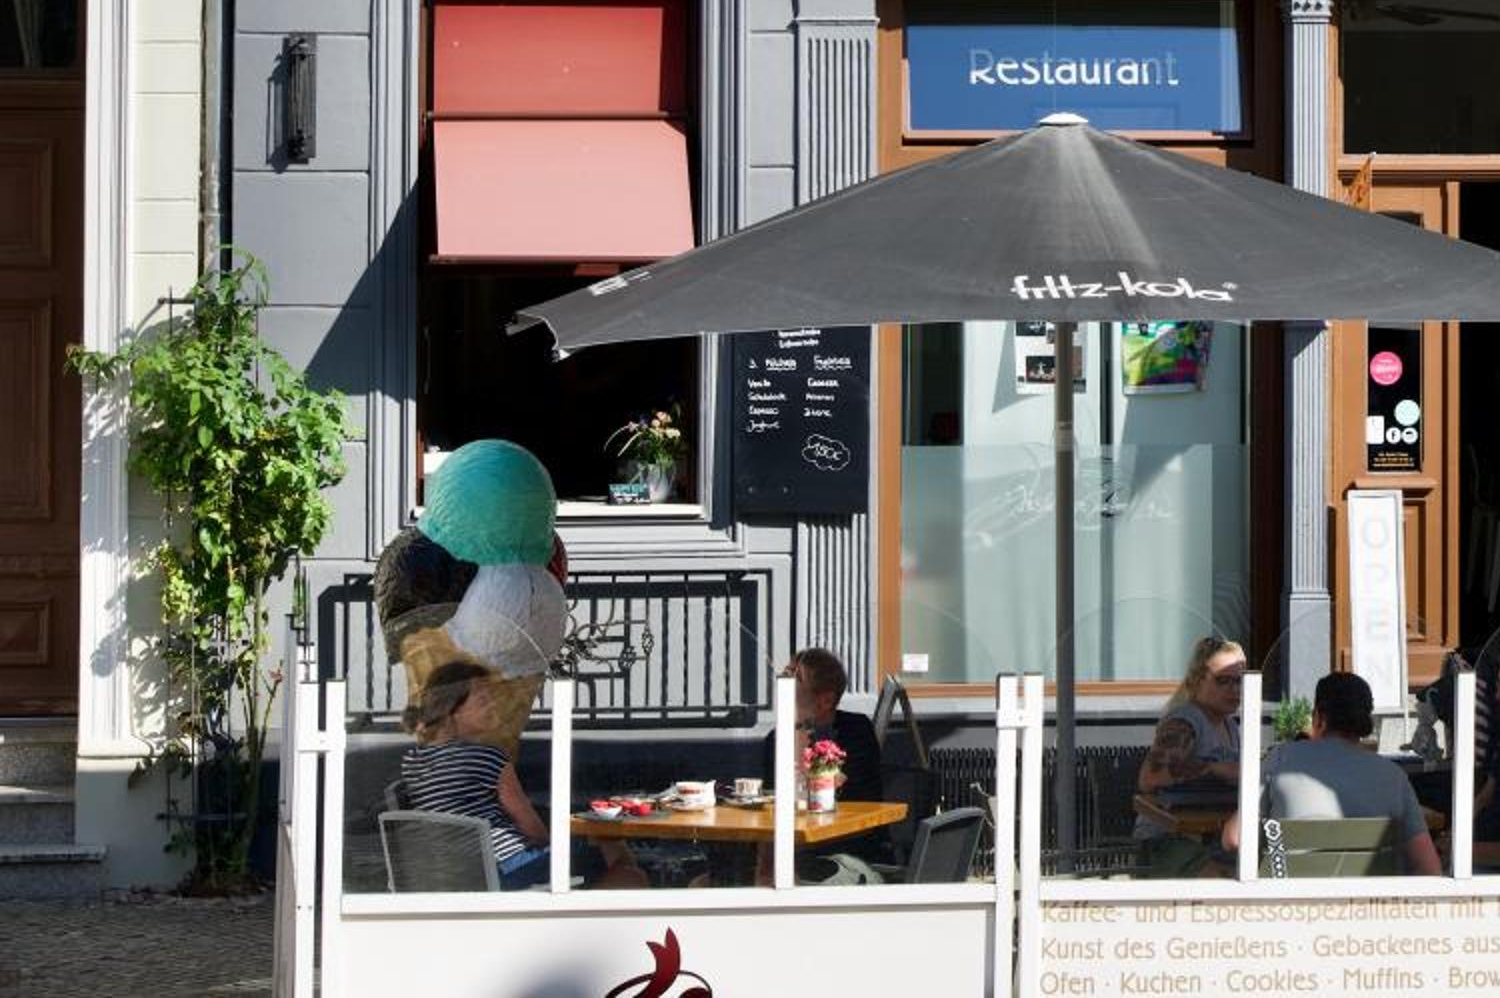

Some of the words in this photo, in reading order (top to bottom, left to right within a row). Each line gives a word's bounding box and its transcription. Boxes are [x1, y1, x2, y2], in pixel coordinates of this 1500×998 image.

[969, 48, 1179, 86] Restaurant
[1010, 271, 1234, 301] fritz-kola
[1135, 899, 1177, 923] und
[1190, 896, 1438, 925] Espressospezialitäten
[1450, 896, 1484, 918] mit
[1040, 937, 1104, 960] Kunst
[1114, 936, 1156, 959] des
[1167, 936, 1289, 959] Genießens
[1312, 933, 1454, 957] Gebackenes
[1039, 970, 1096, 995] Ofen
[1120, 970, 1202, 994] Kuchen
[1226, 968, 1319, 993] Cookies
[1342, 966, 1425, 990] Muffins
